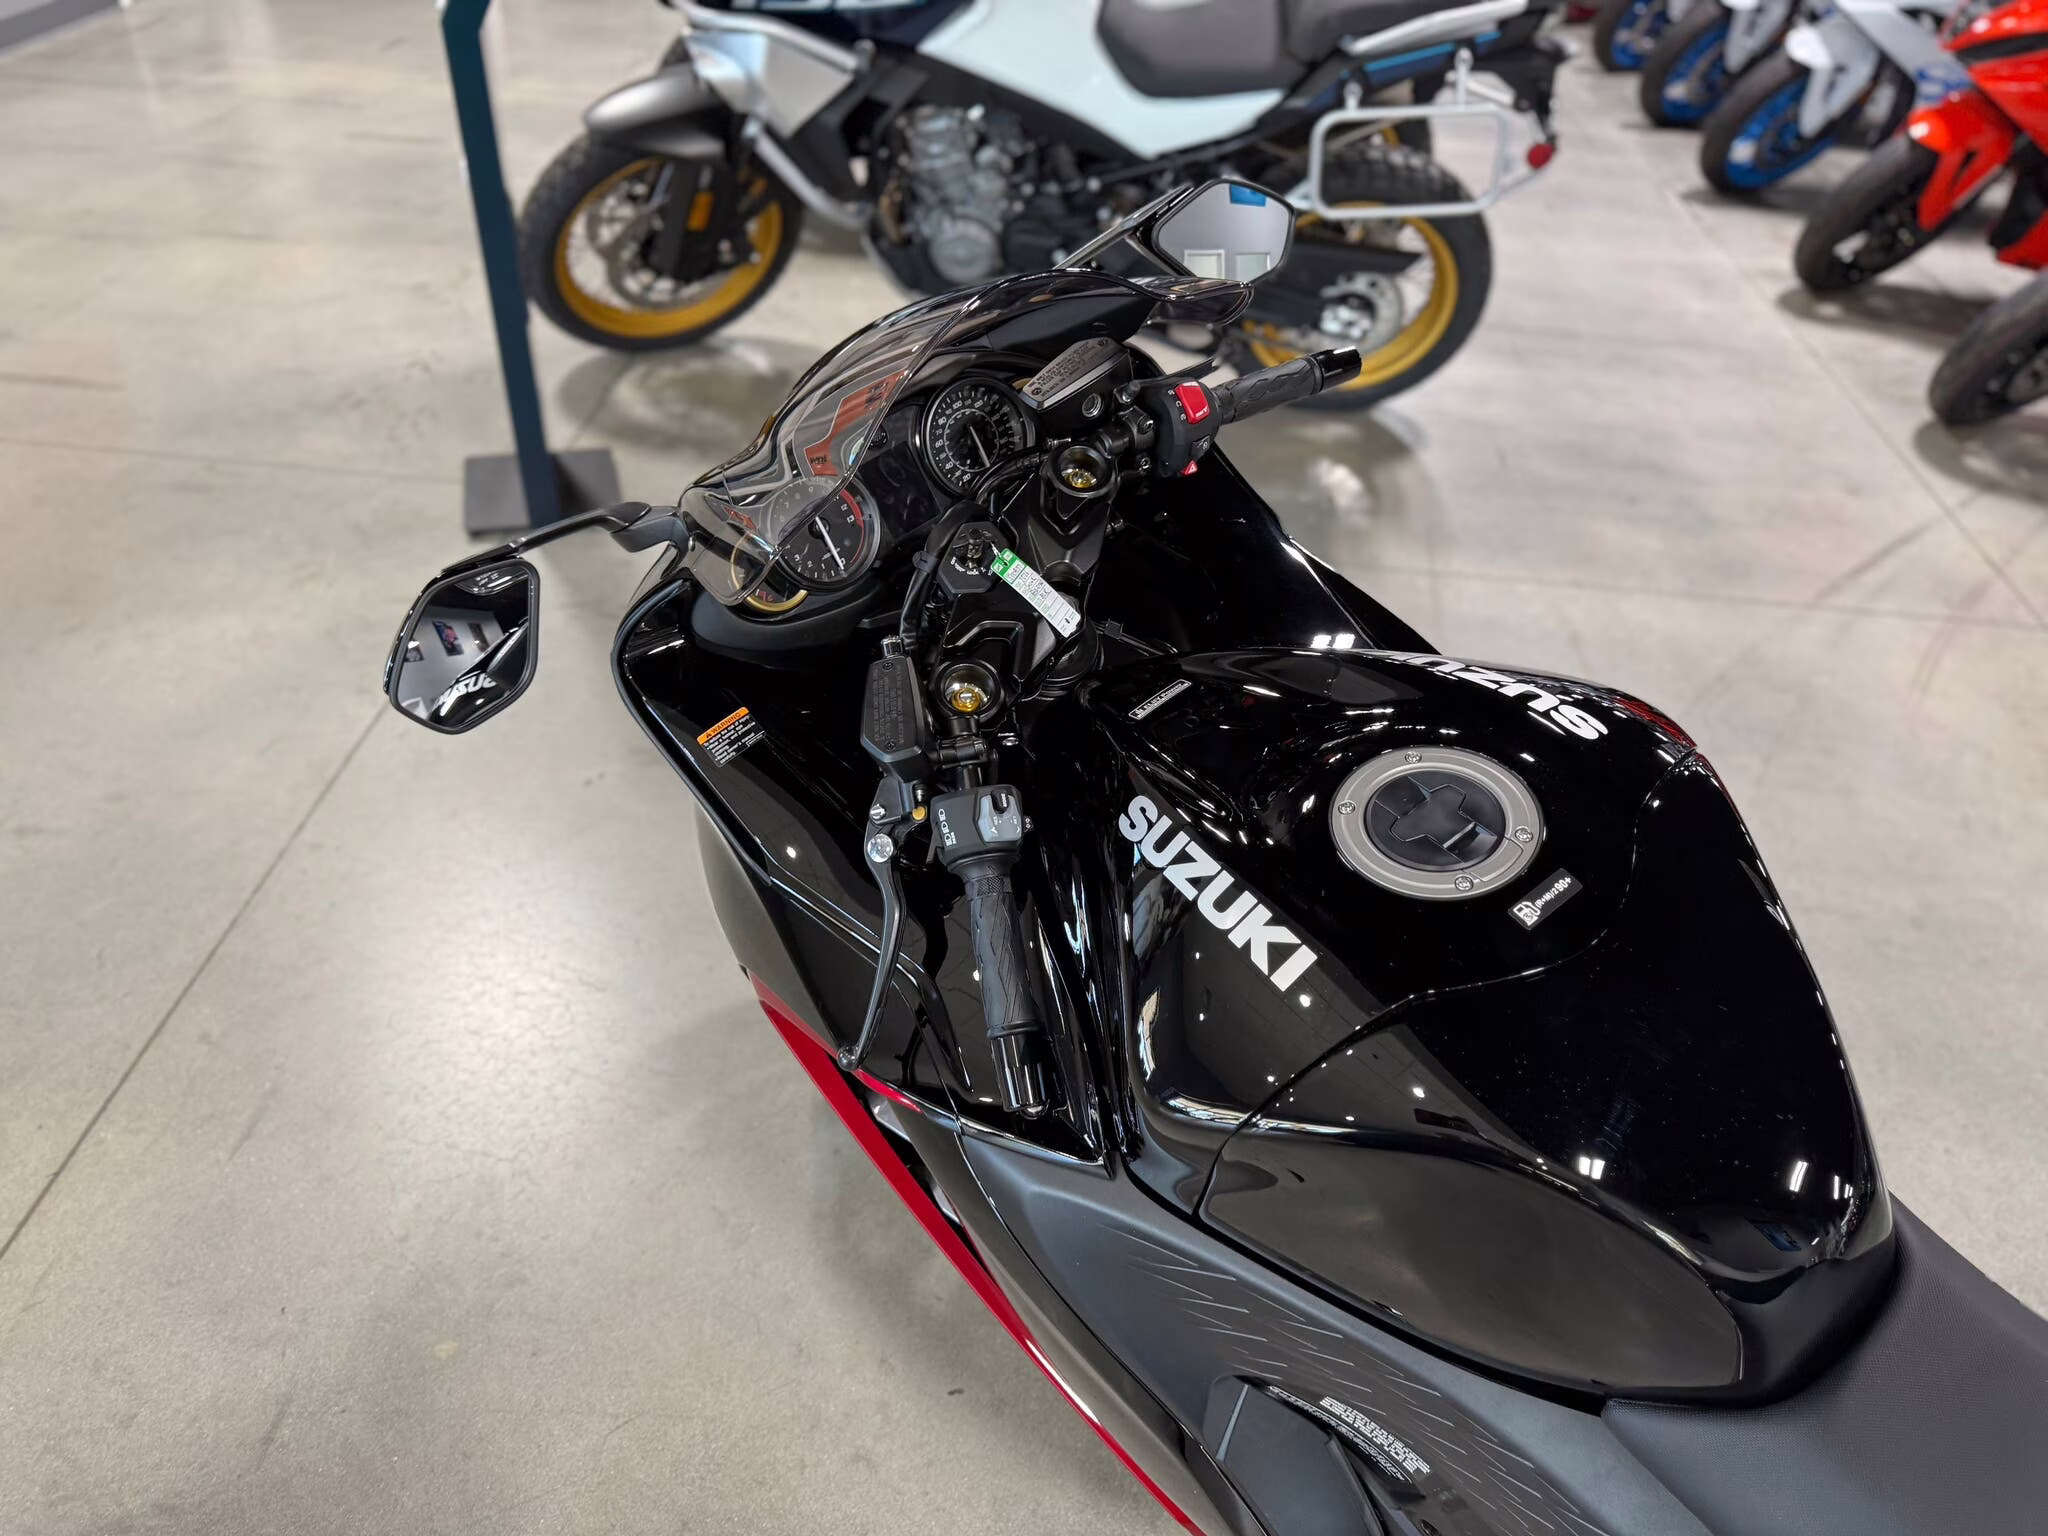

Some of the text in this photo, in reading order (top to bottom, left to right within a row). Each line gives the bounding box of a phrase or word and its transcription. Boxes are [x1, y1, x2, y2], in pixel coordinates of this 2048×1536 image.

[935, 439, 944, 448] 60
[945, 461, 954, 470] 40
[712, 712, 741, 734] WARNING
[1118, 795, 1318, 992] SUZUKI
[1535, 877, 1572, 909] (R+M)/2 90+
